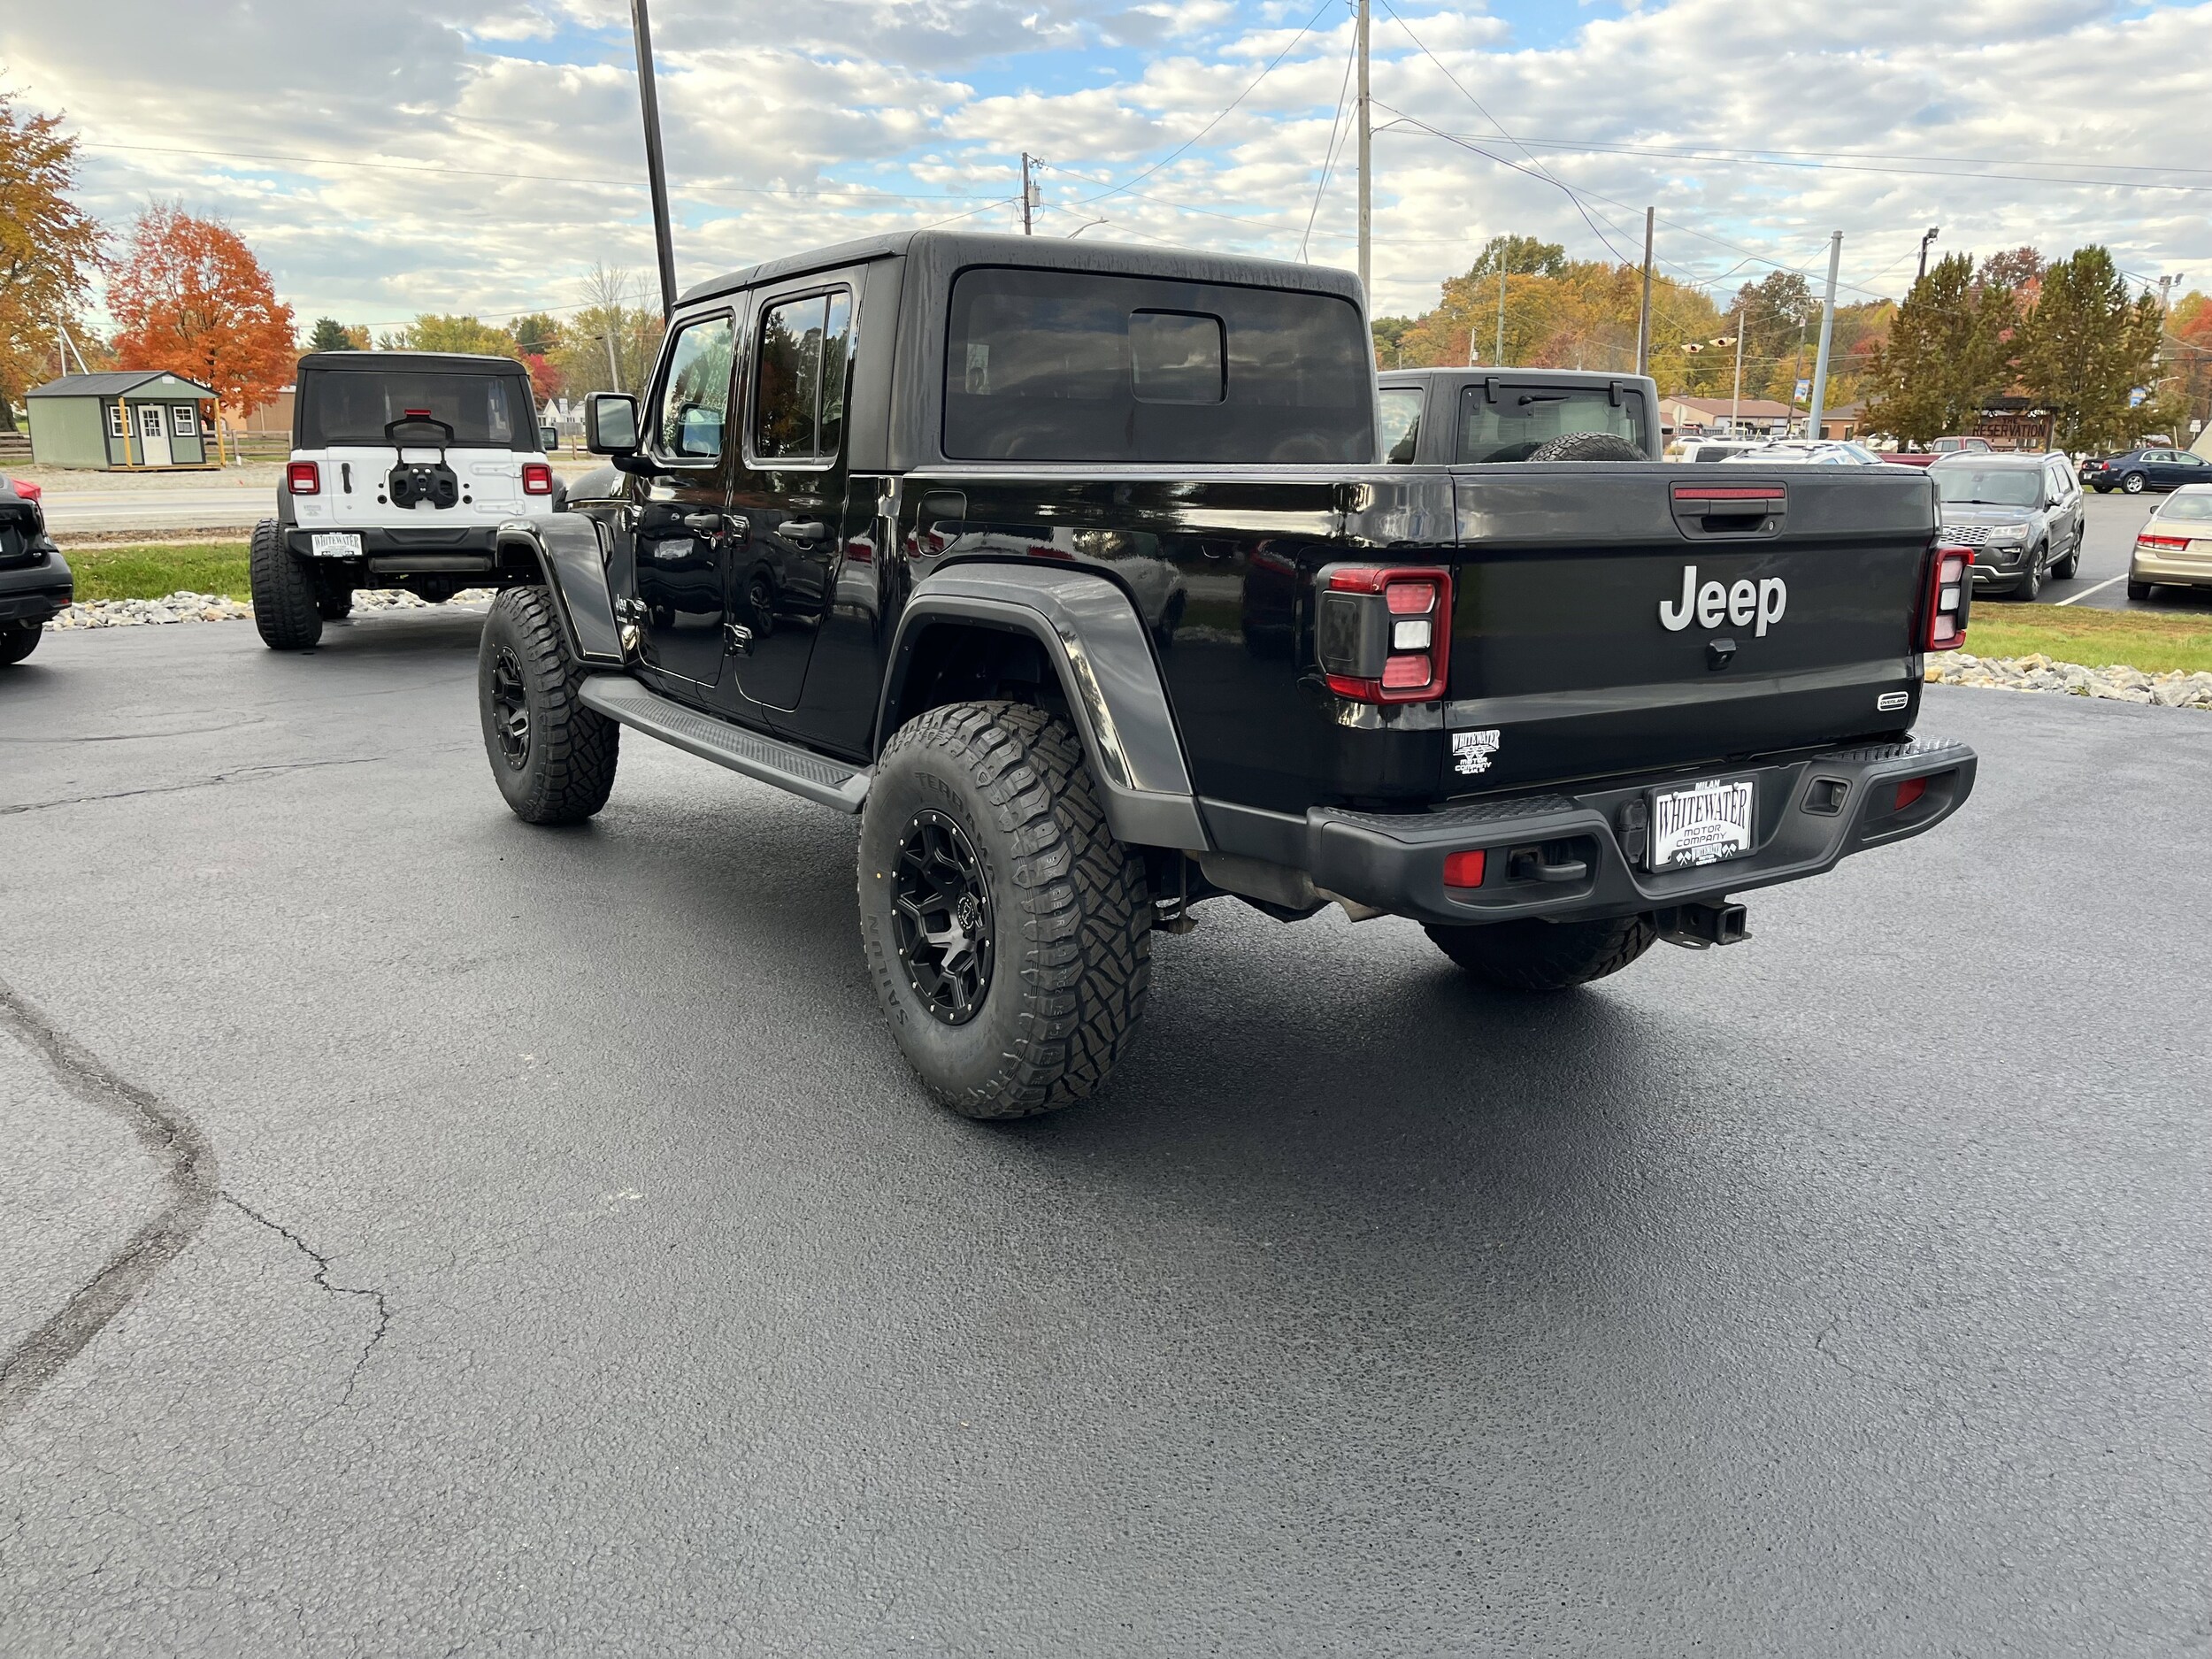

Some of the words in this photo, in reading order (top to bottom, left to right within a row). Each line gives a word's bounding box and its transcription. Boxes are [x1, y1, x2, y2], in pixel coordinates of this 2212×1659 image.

[2002, 416, 2018, 425] THE
[1972, 424, 2047, 438] RESERVATION
[314, 535, 360, 549] WHITEWATER
[1659, 565, 1787, 637] Jeep
[1452, 729, 1501, 753] WHITEWATER
[1455, 761, 1492, 772] COMPANY
[1460, 757, 1488, 765] MOTOR
[1694, 780, 1721, 791] MILAN
[1659, 788, 1747, 843] WHITEWATER
[1684, 824, 1721, 838] MOTOR
[1676, 832, 1727, 848] COMPANY
[867, 913, 909, 1025] SAILUN
